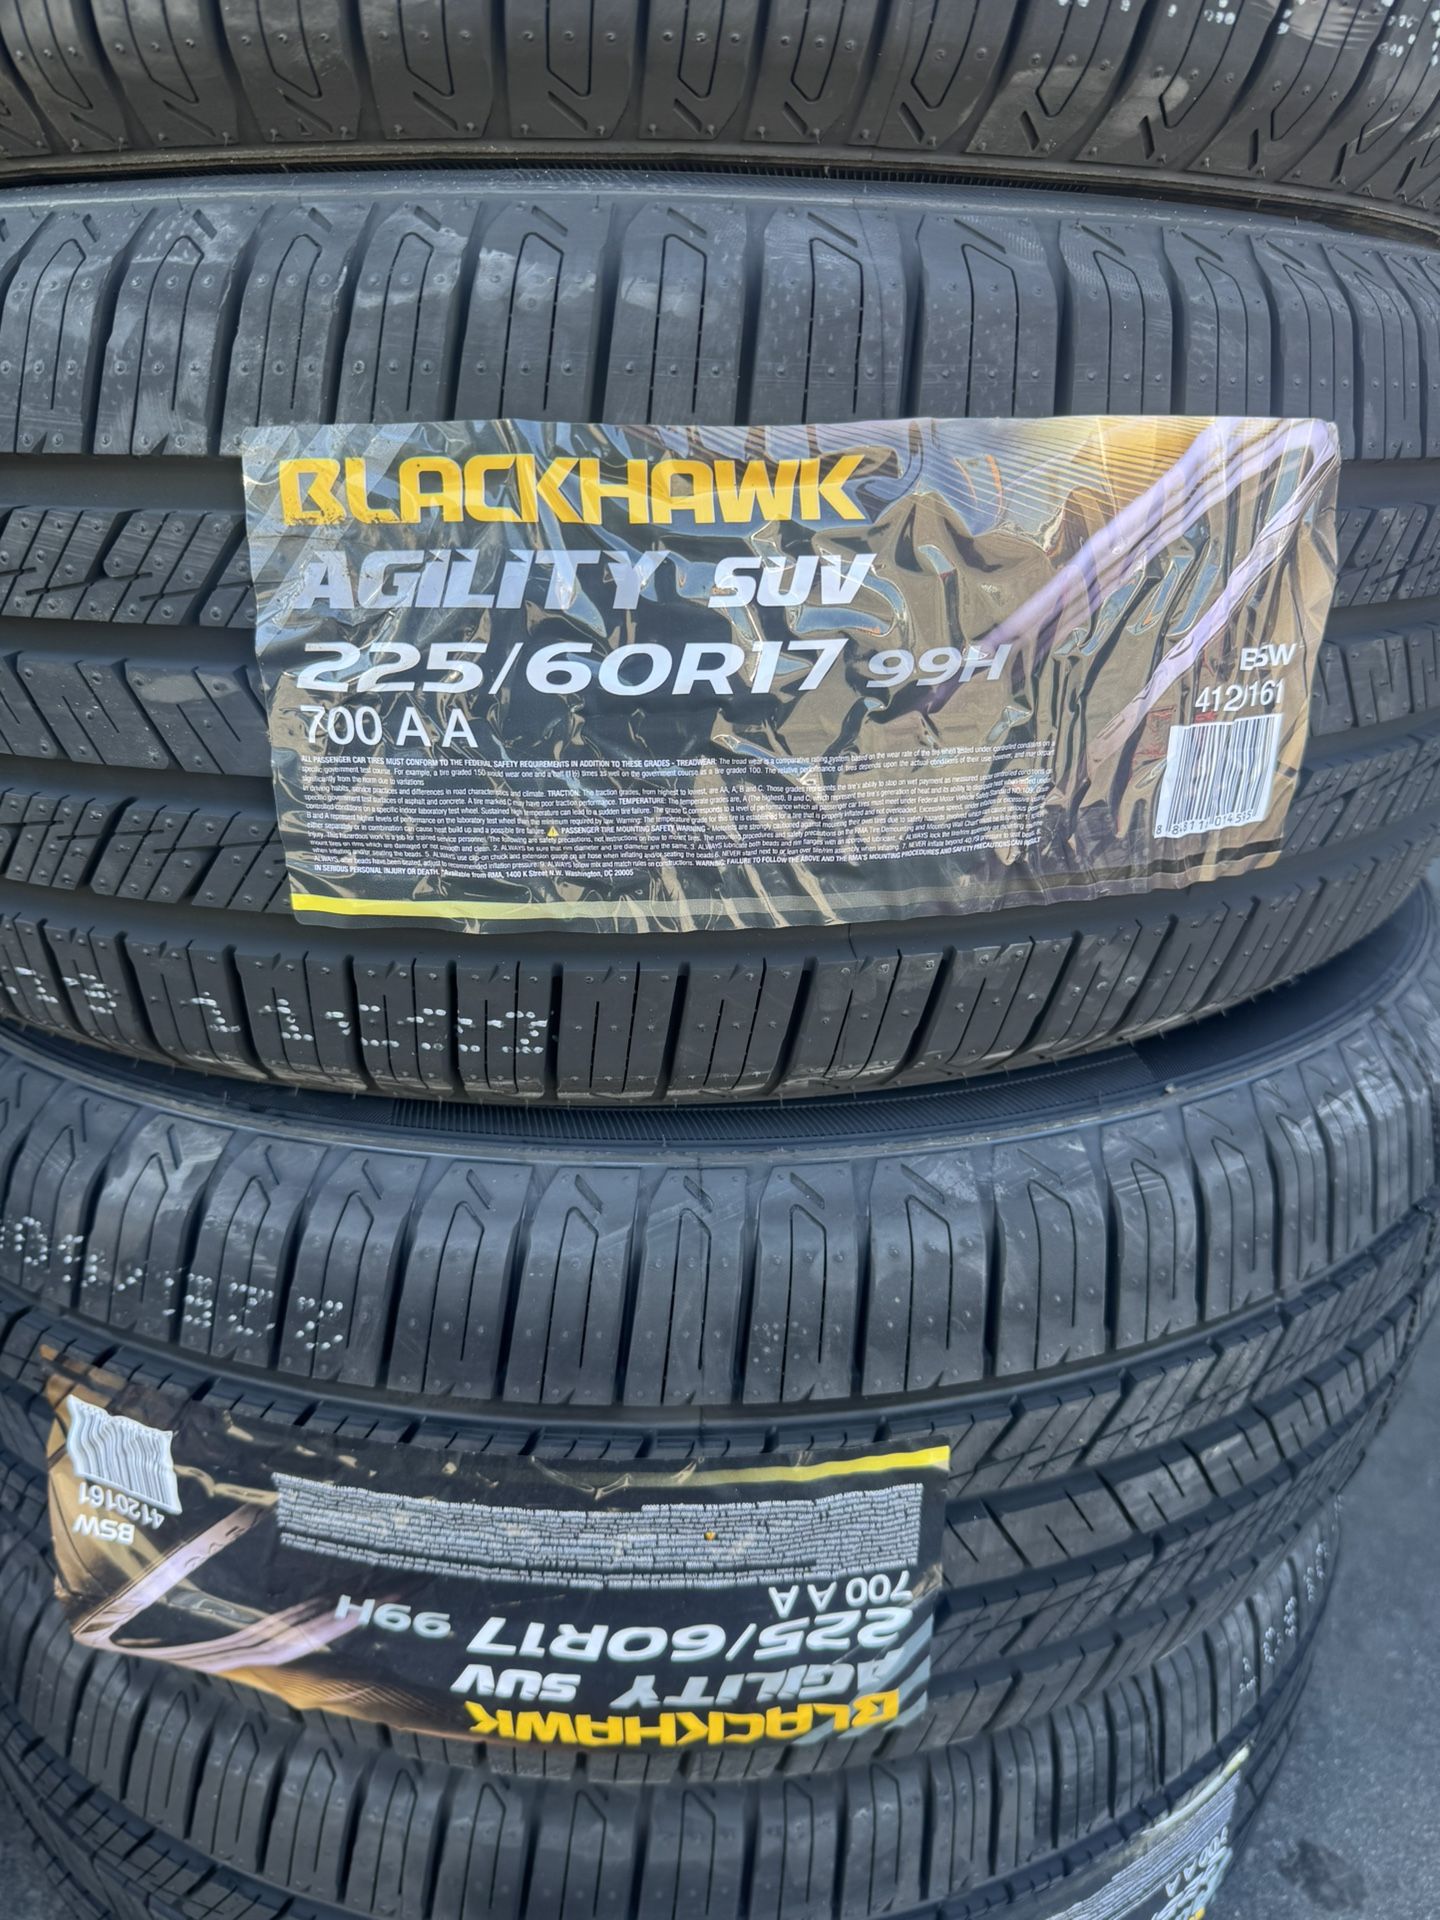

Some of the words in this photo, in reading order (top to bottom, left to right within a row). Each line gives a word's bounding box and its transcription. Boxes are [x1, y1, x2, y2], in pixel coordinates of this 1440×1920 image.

[278, 454, 867, 527] BLACKHAWK
[293, 549, 672, 609] AGILITY
[709, 553, 876, 609] SUV
[296, 638, 849, 695] 225/60R17
[866, 646, 1013, 688] 99H
[300, 705, 383, 746] 700
[396, 707, 432, 746] A
[441, 708, 478, 748] A
[313, 756, 351, 764] PASSENGER
[368, 757, 384, 765] TIRES
[520, 760, 569, 768] REQUIREMENTS
[622, 760, 642, 768] THESE
[776, 757, 810, 766] comparative
[642, 770, 676, 778] government
[726, 767, 746, 775] graded
[561, 826, 599, 834] PASSENGER
[350, 866, 382, 874] PERSONAL
[565, 870, 603, 878] Washington,
[79, 1482, 164, 1519] 4120161
[73, 1513, 135, 1545] BSW
[768, 1585, 799, 1618] A
[807, 1581, 837, 1613] A
[845, 1570, 913, 1607] 700
[335, 1594, 451, 1638] 99H
[466, 1607, 913, 1661] 225/60R17
[450, 1664, 581, 1701] SUV
[609, 1648, 905, 1709] AGILITY
[465, 1688, 899, 1745] BLACKHAWK
